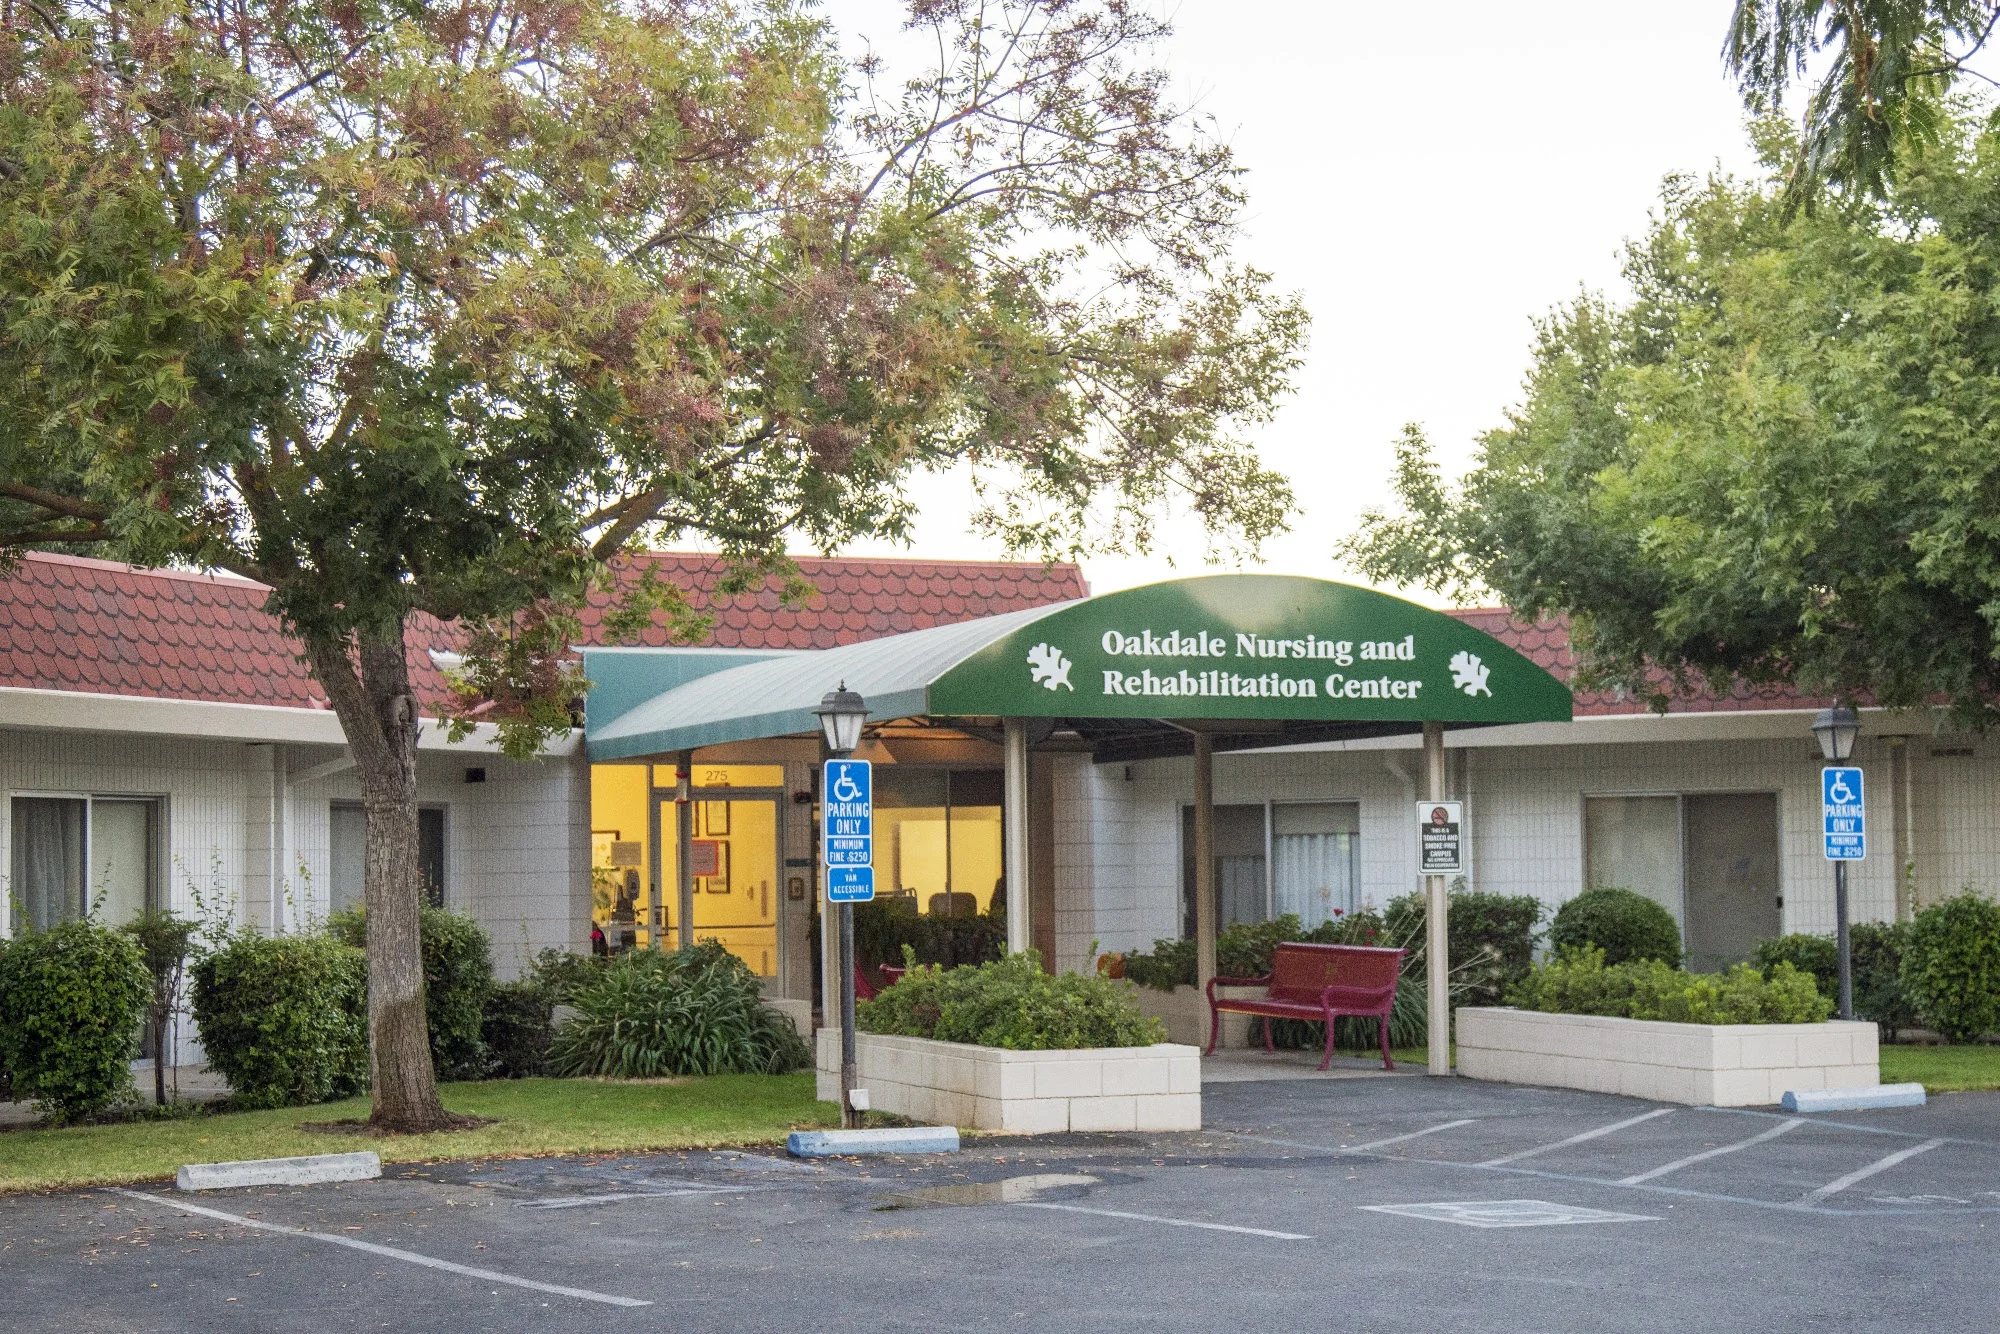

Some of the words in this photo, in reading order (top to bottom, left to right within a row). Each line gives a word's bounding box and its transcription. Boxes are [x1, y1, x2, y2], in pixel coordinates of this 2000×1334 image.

[1101, 629, 1226, 657] Oakdale
[1235, 633, 1353, 667] Nursing
[1360, 634, 1416, 661] and
[1102, 668, 1317, 698] Rehabilitation
[1325, 673, 1423, 699] Center
[705, 770, 728, 781] 275
[827, 802, 869, 818] PARKING
[1825, 804, 1862, 818] PARKING
[836, 819, 861, 835] ONLY
[1832, 818, 1856, 832] ONLY
[833, 839, 864, 850] MINIMUM
[1830, 836, 1858, 846] MINIMUM
[829, 851, 844, 862] FINE
[847, 851, 868, 862] $250
[1430, 850, 1452, 858] CAMPUS
[1827, 846, 1842, 857] FINE
[844, 874, 857, 882] VAN
[833, 884, 869, 894] ACCESSIBLE
